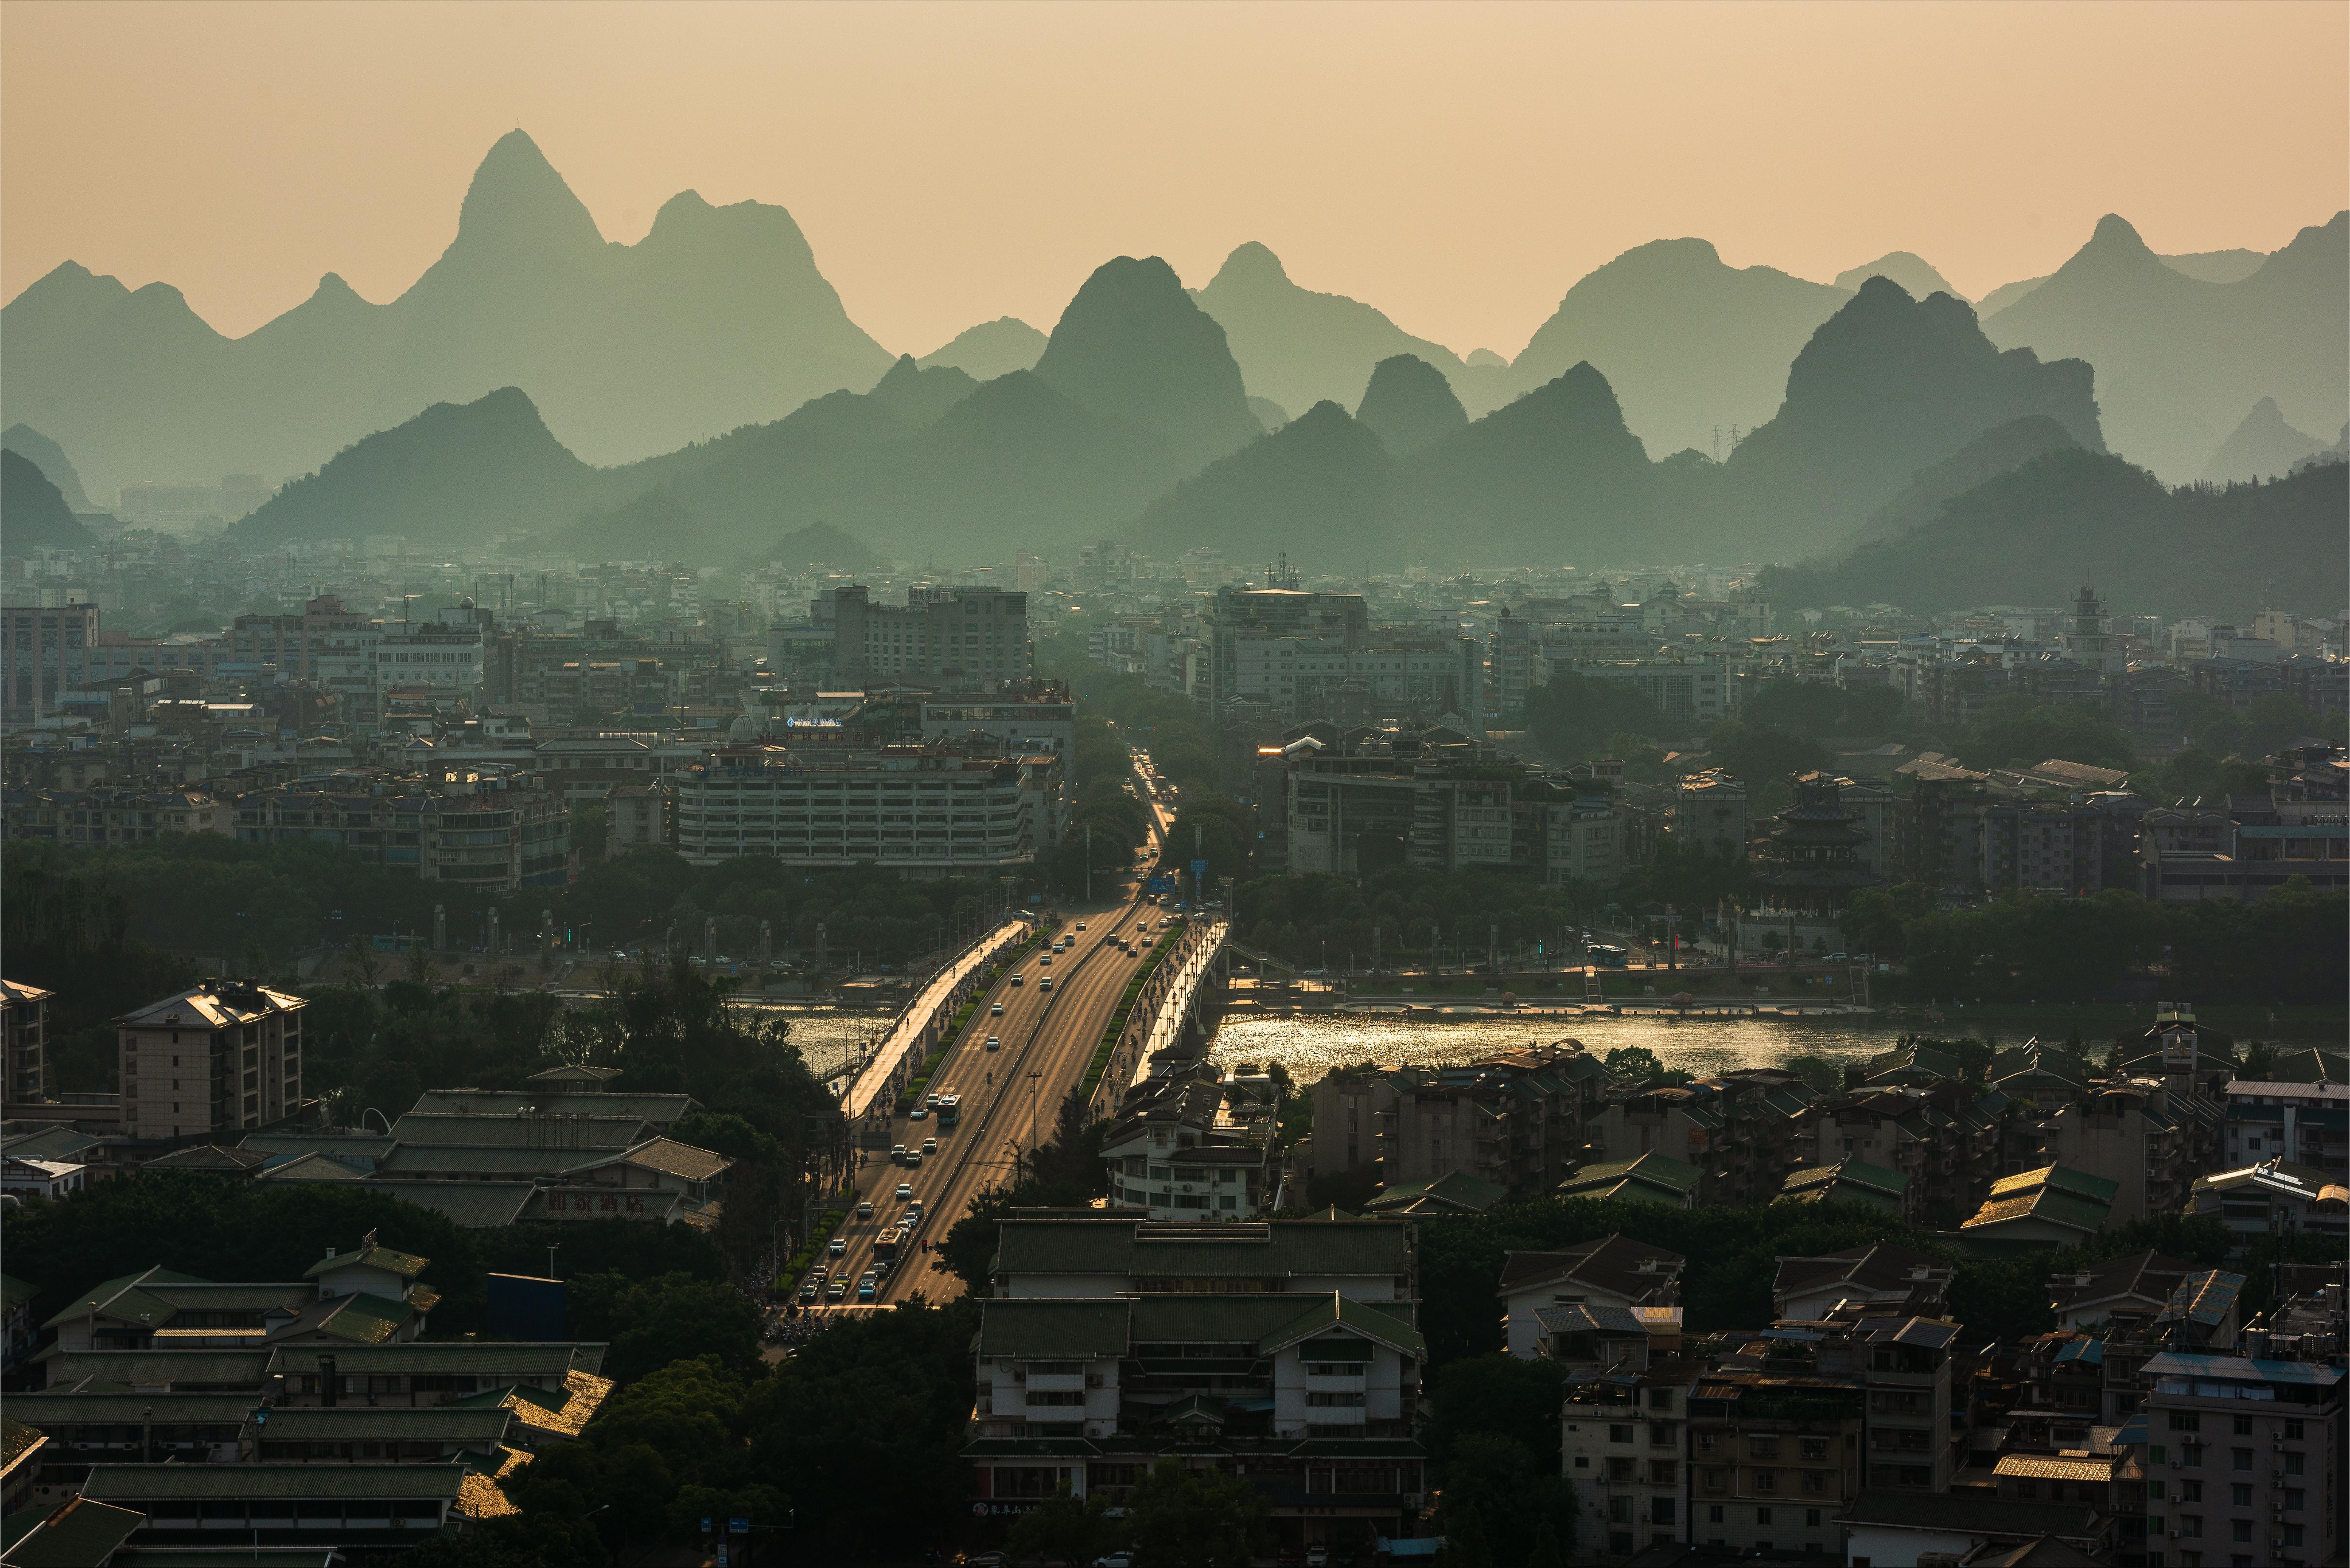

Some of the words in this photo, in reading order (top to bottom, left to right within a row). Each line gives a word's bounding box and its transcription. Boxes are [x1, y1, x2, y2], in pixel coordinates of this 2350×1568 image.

[785, 731, 879, 742] 环球国际酒店
[714, 765, 804, 777] 广西北部湾银行
[549, 1192, 644, 1212] 如家酒店
[990, 1504, 1022, 1516] 象鼻山
